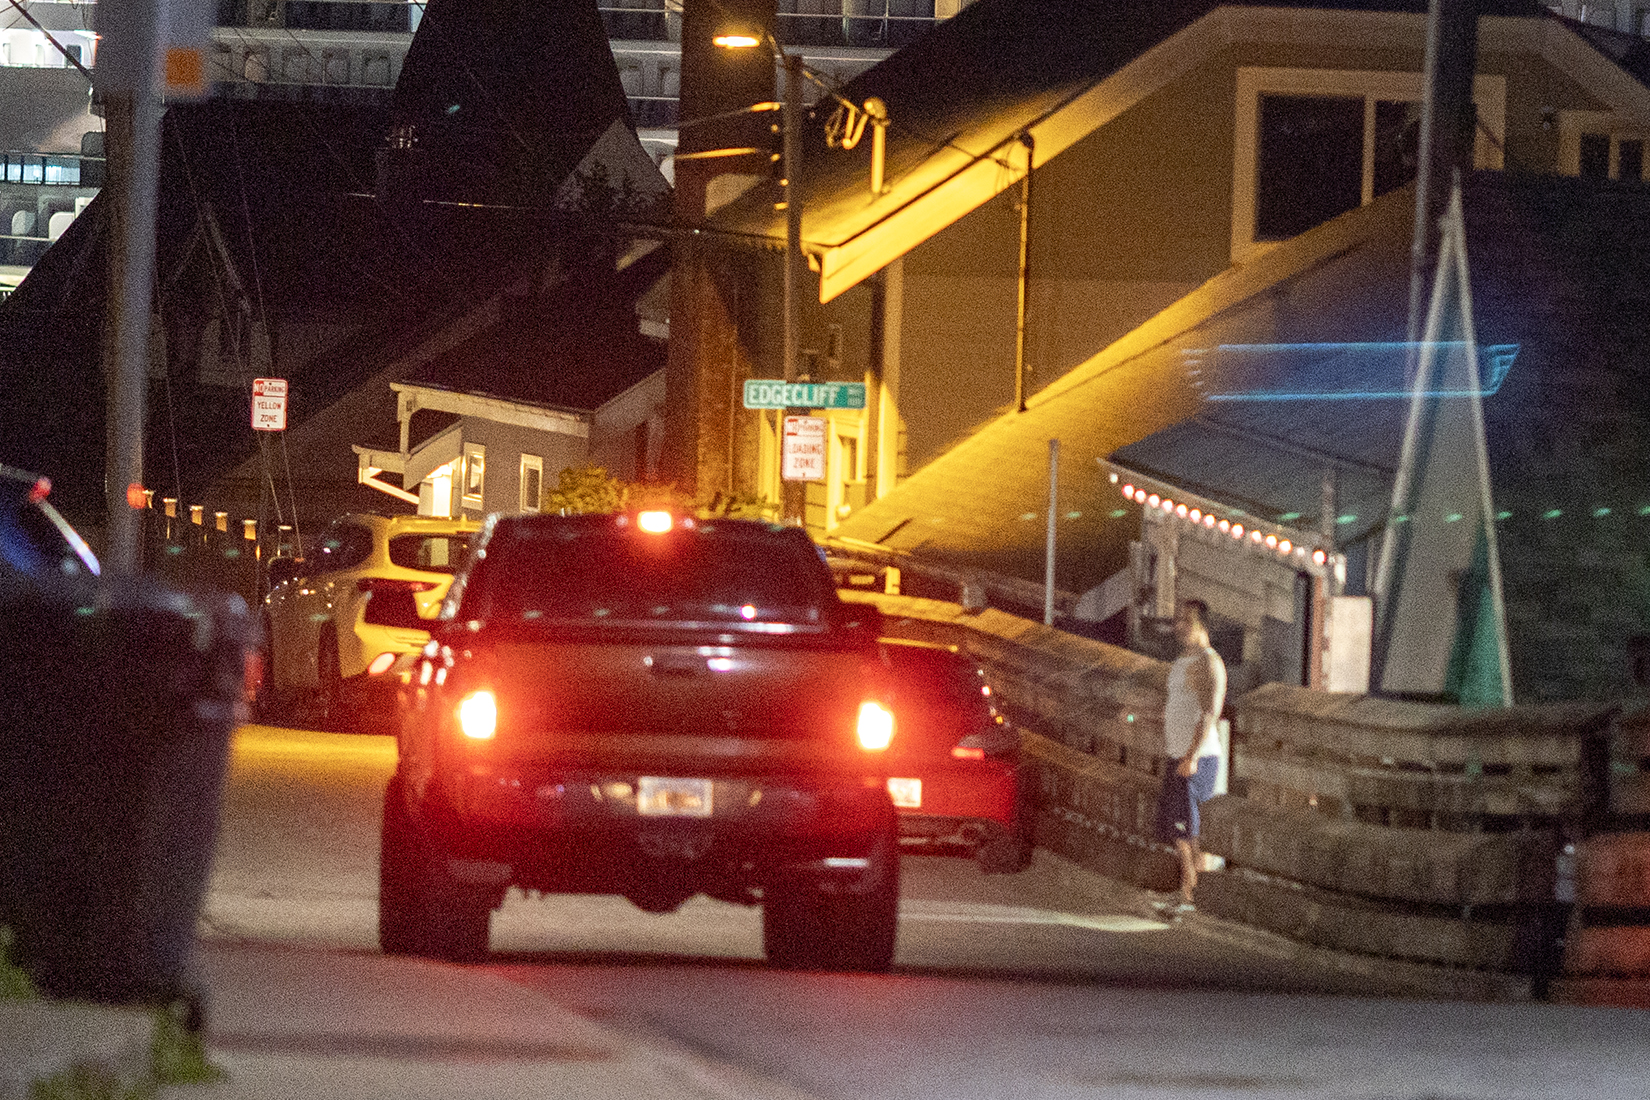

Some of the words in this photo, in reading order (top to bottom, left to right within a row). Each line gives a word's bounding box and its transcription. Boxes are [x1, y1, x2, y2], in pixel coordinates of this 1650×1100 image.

[749, 385, 839, 405] EDGECLIFF
[257, 401, 282, 410] YELLOW
[260, 414, 277, 422] ZONE
[794, 457, 815, 469] ZONE
